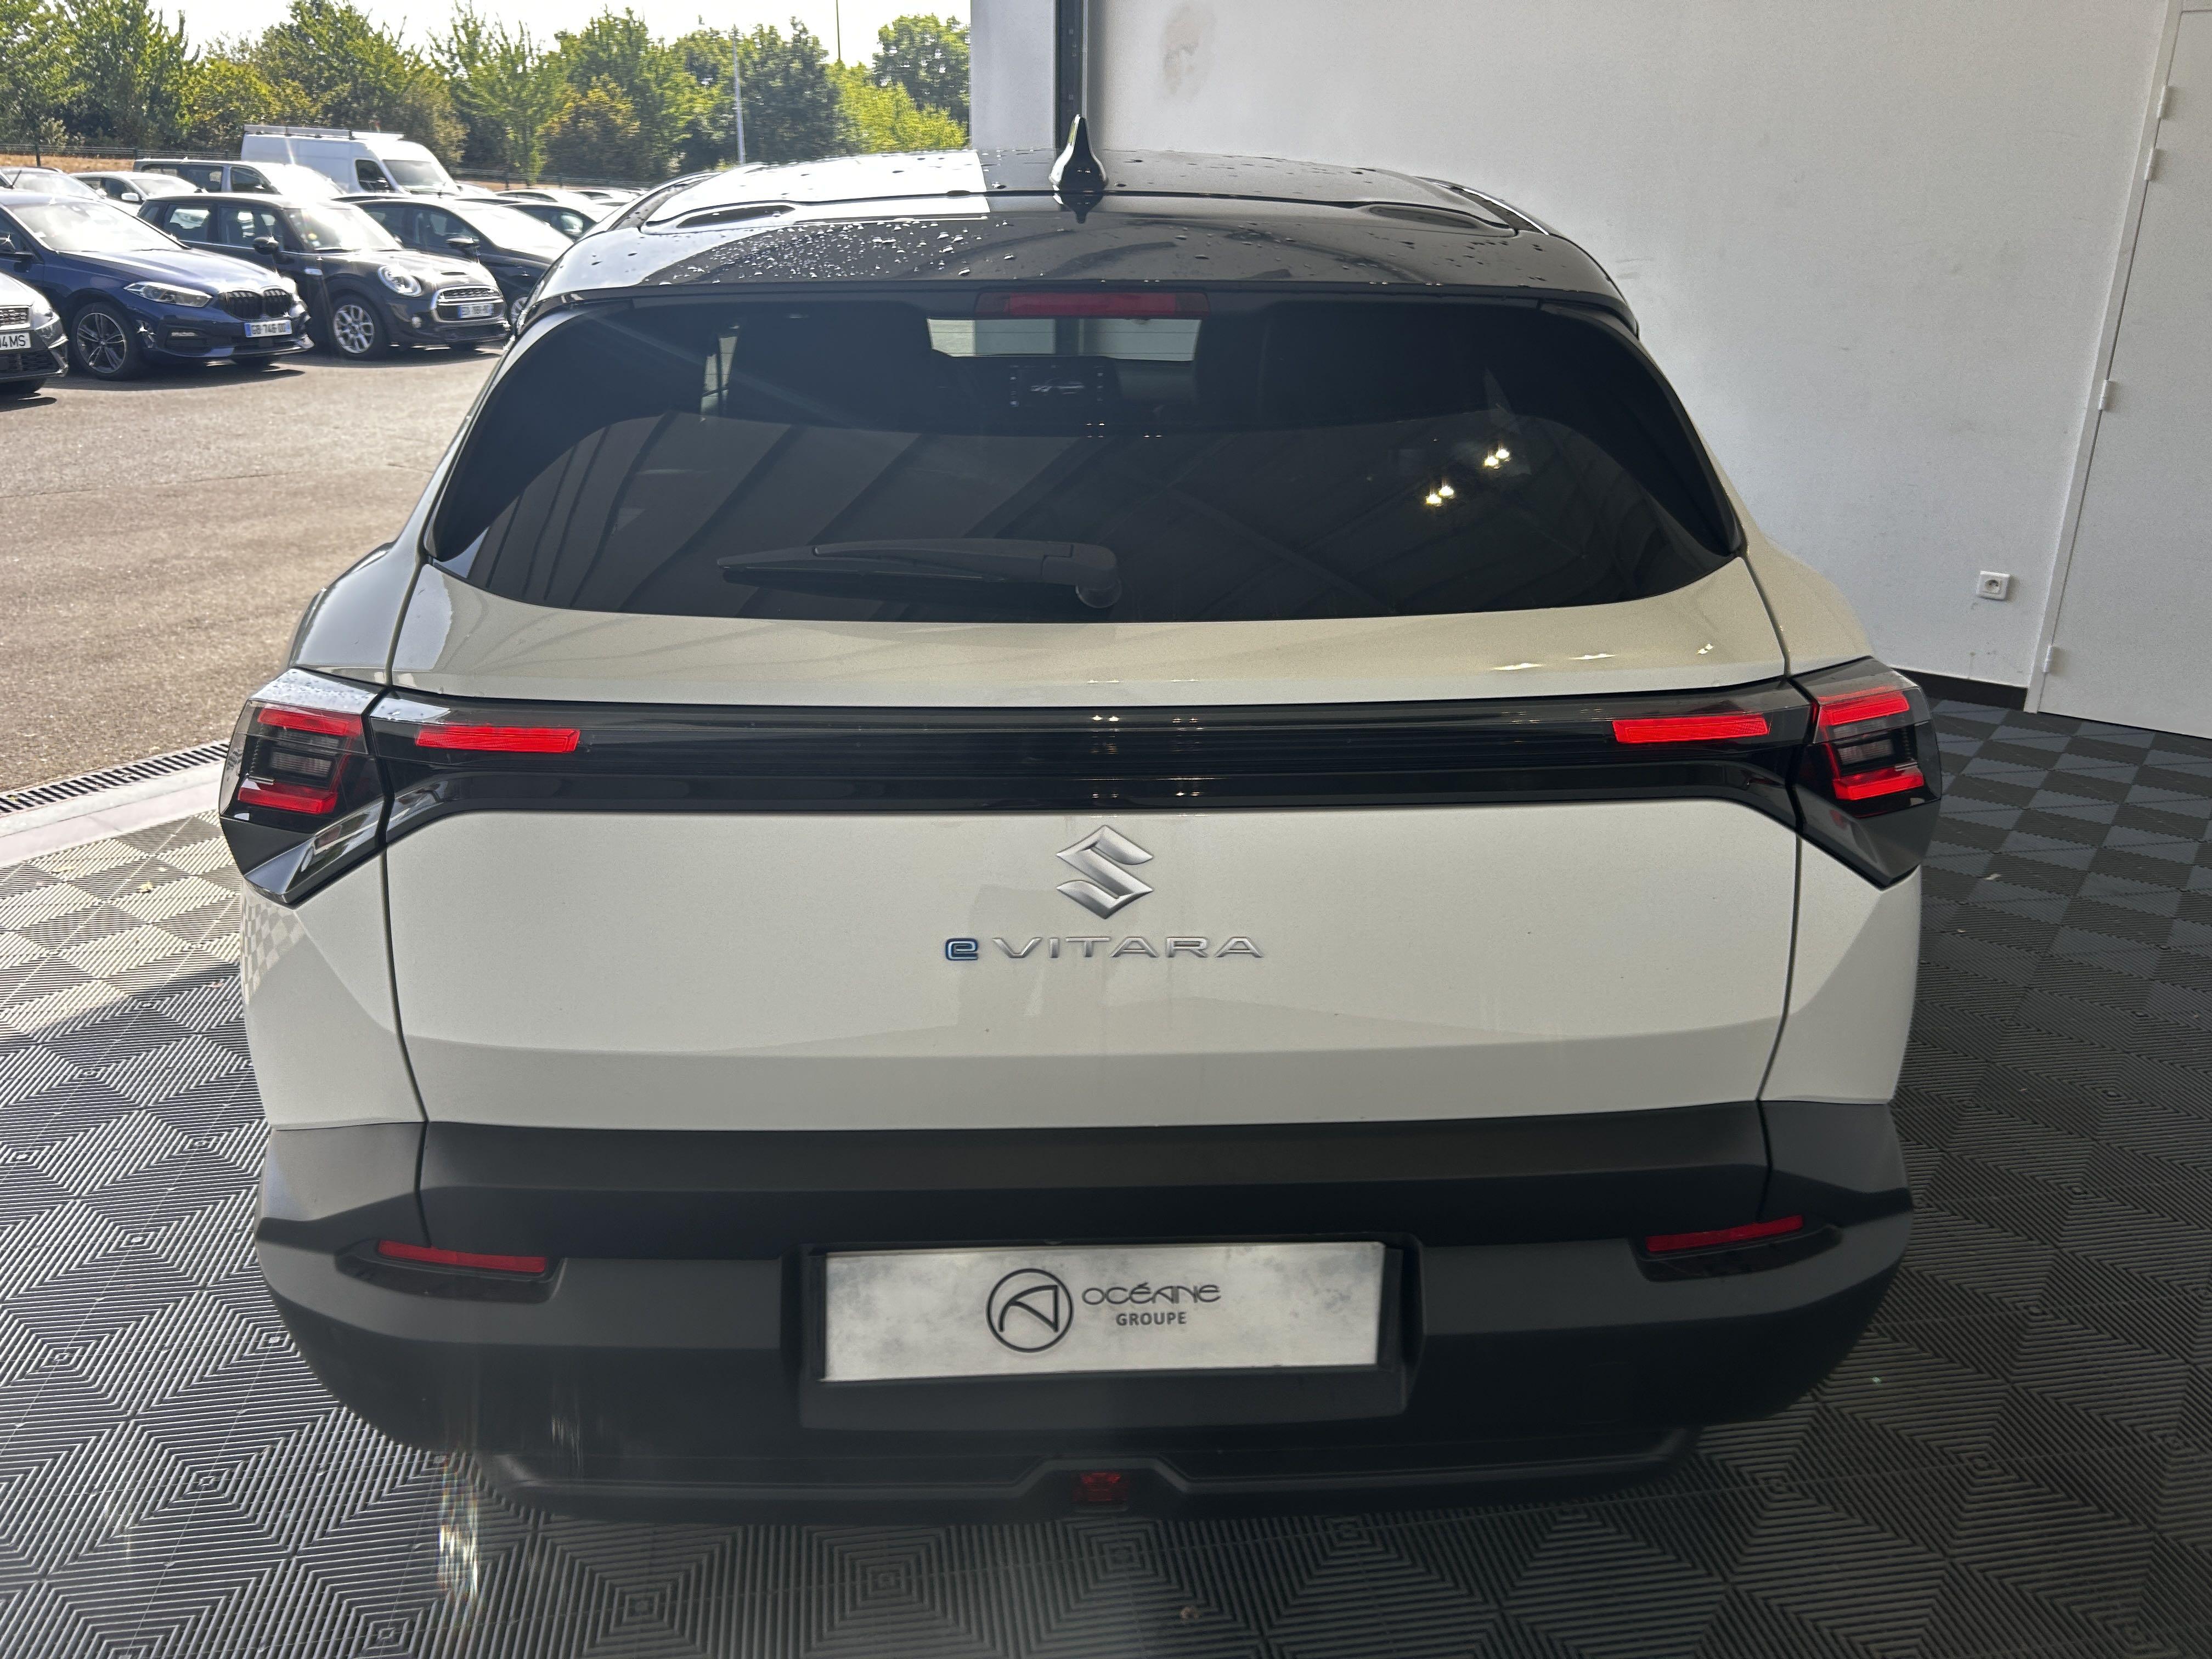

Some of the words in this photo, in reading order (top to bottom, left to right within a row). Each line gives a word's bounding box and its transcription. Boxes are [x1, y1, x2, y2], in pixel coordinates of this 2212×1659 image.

[0, 335, 26, 348] 4MS
[945, 937, 979, 961] e
[992, 936, 1263, 958] VITARA
[1116, 1312, 1187, 1326] GROUPE
